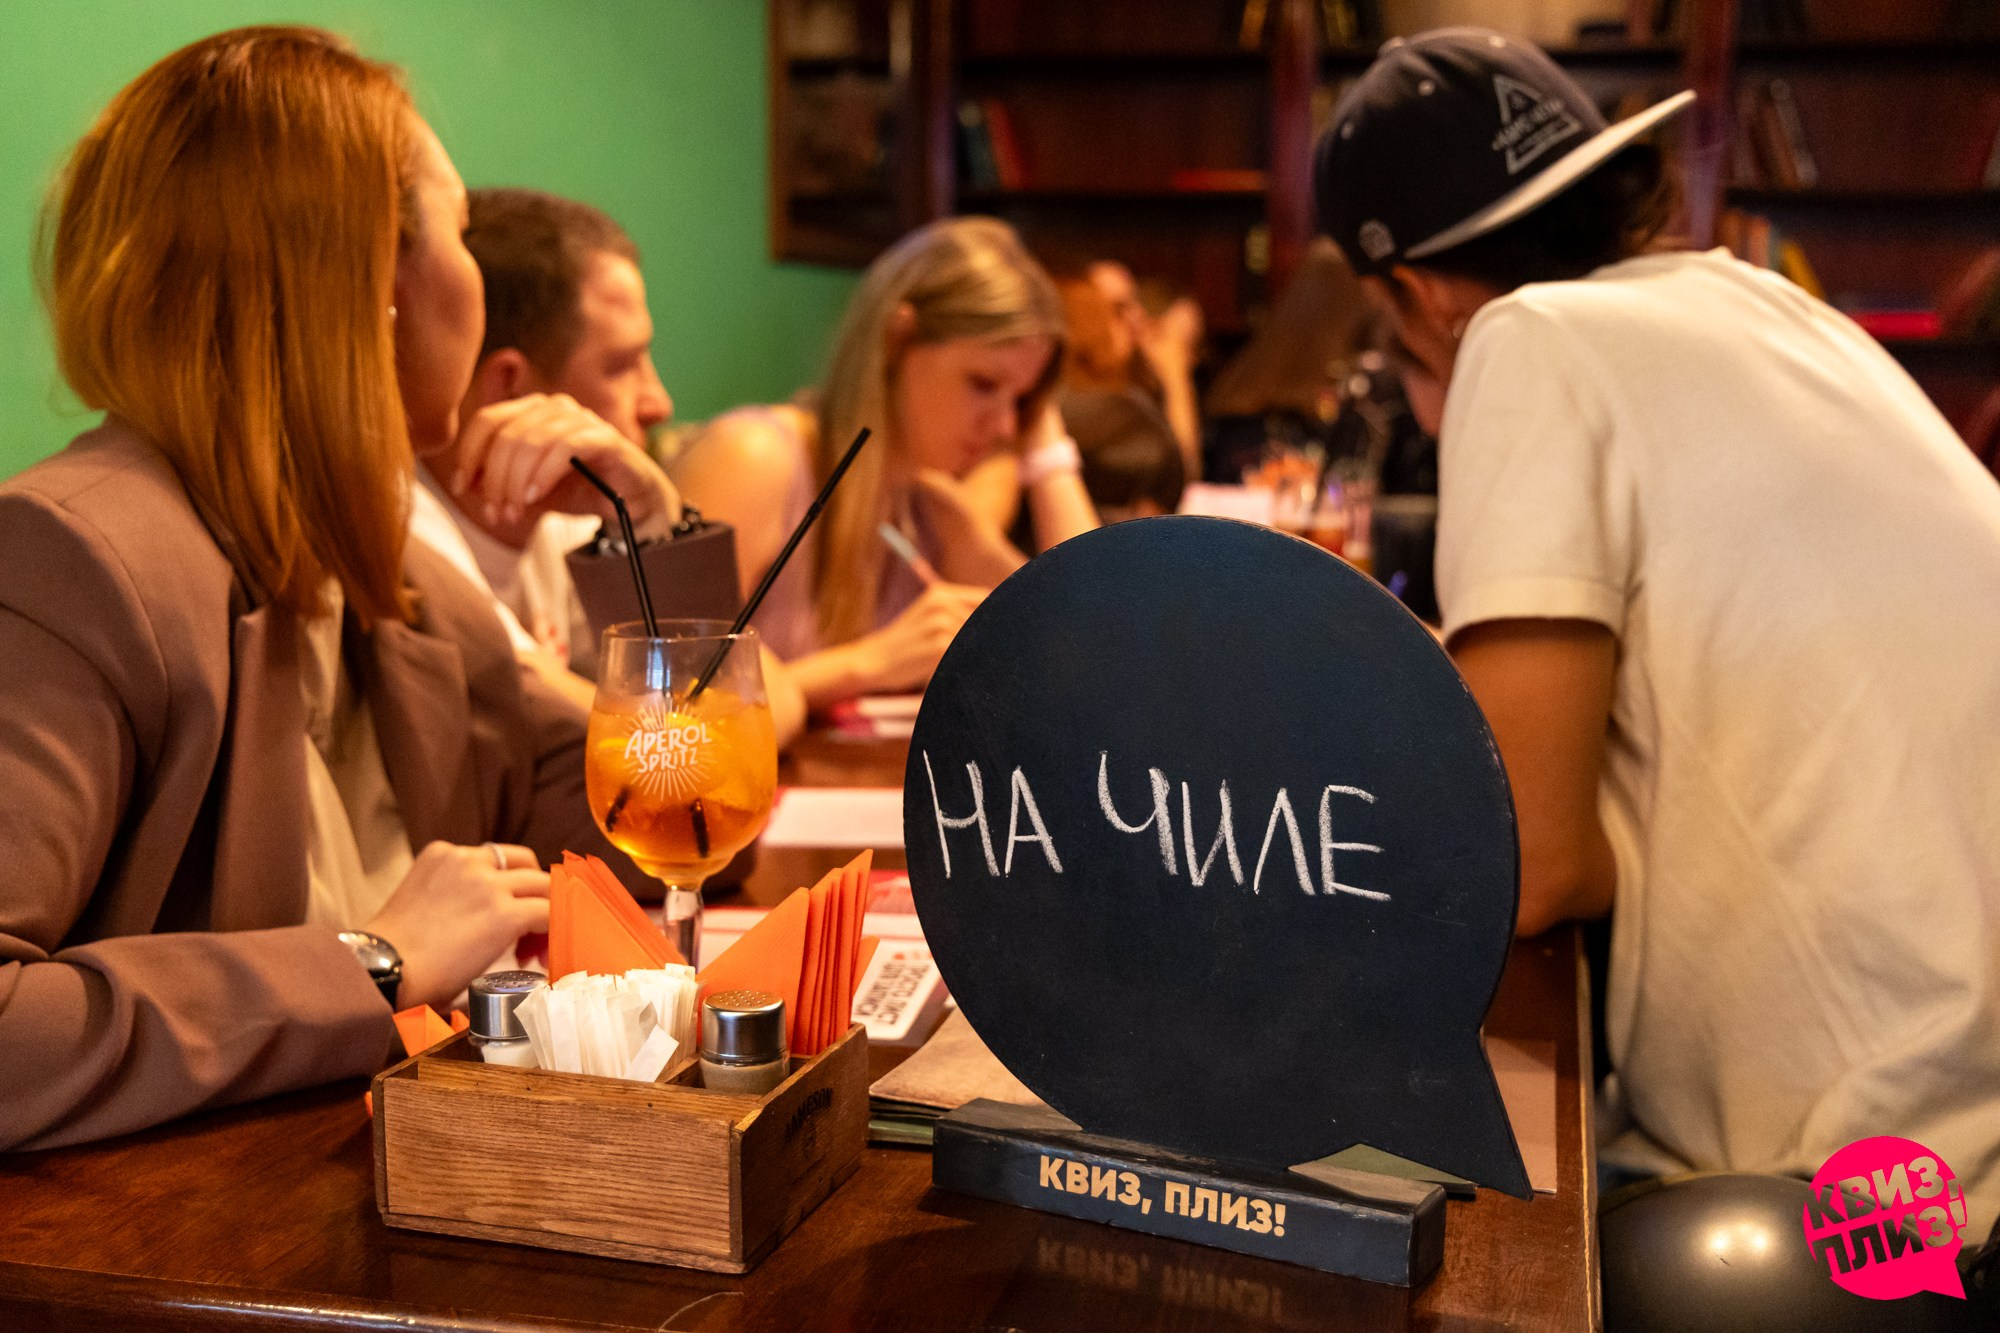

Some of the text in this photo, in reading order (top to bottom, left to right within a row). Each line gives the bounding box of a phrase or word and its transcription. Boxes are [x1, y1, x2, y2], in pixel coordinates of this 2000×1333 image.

[624, 723, 712, 759] APEROL
[637, 748, 698, 773] SPRITZ
[924, 749, 1393, 900] НА ЧИЛЕ
[1039, 1155, 1286, 1237] КВИЗ, ПЛИЗ!
